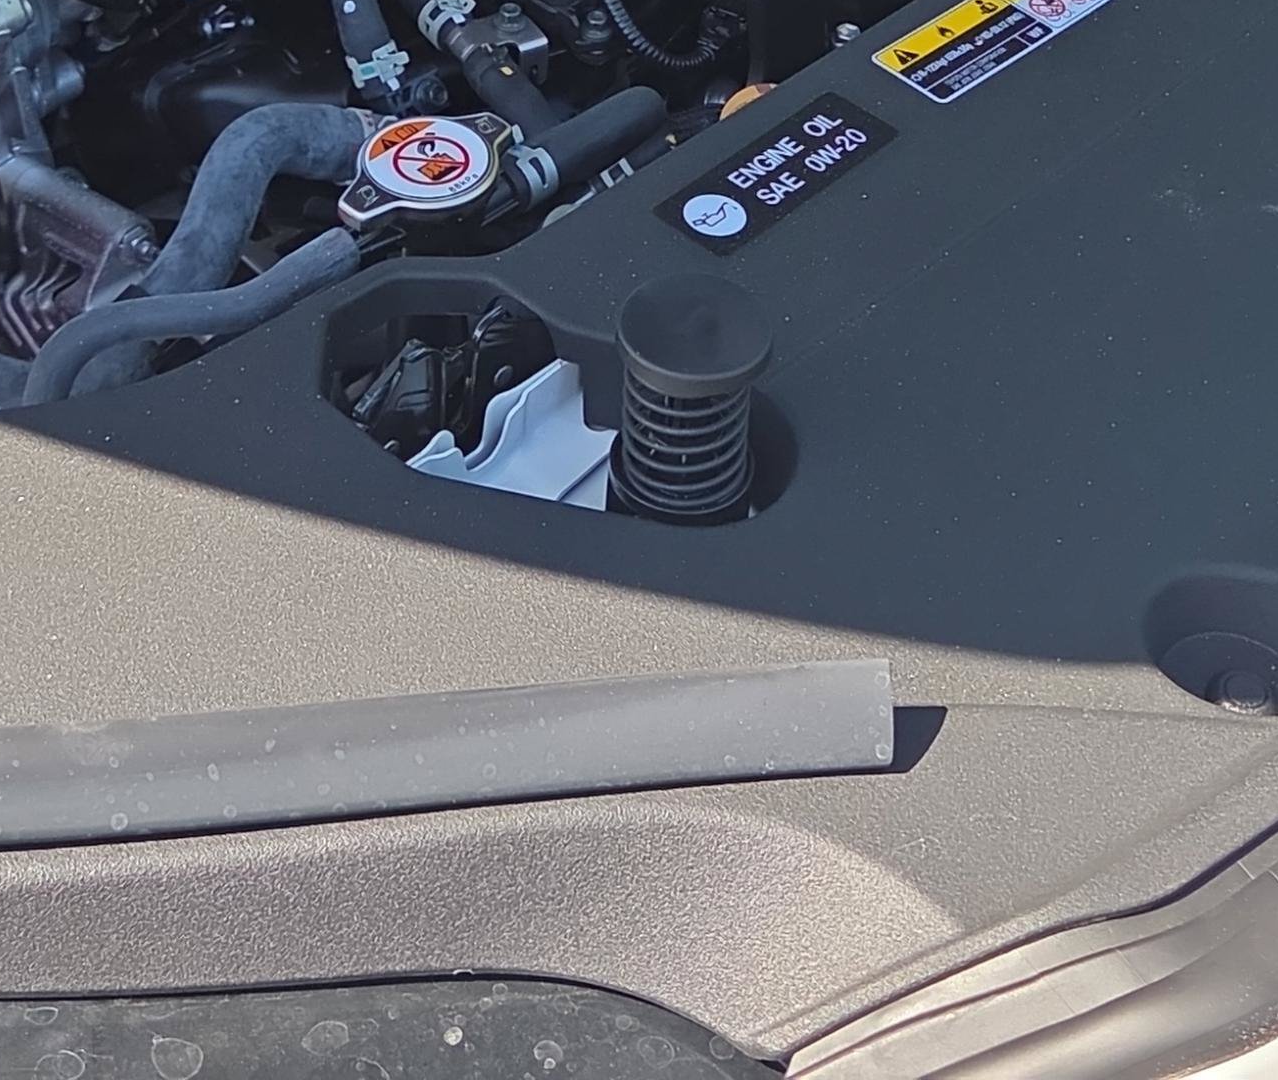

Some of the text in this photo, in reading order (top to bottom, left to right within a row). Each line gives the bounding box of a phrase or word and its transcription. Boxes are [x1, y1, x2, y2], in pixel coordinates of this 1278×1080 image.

[727, 114, 843, 189] ENGINE OIL
[756, 128, 867, 205] SAE 0W-20
